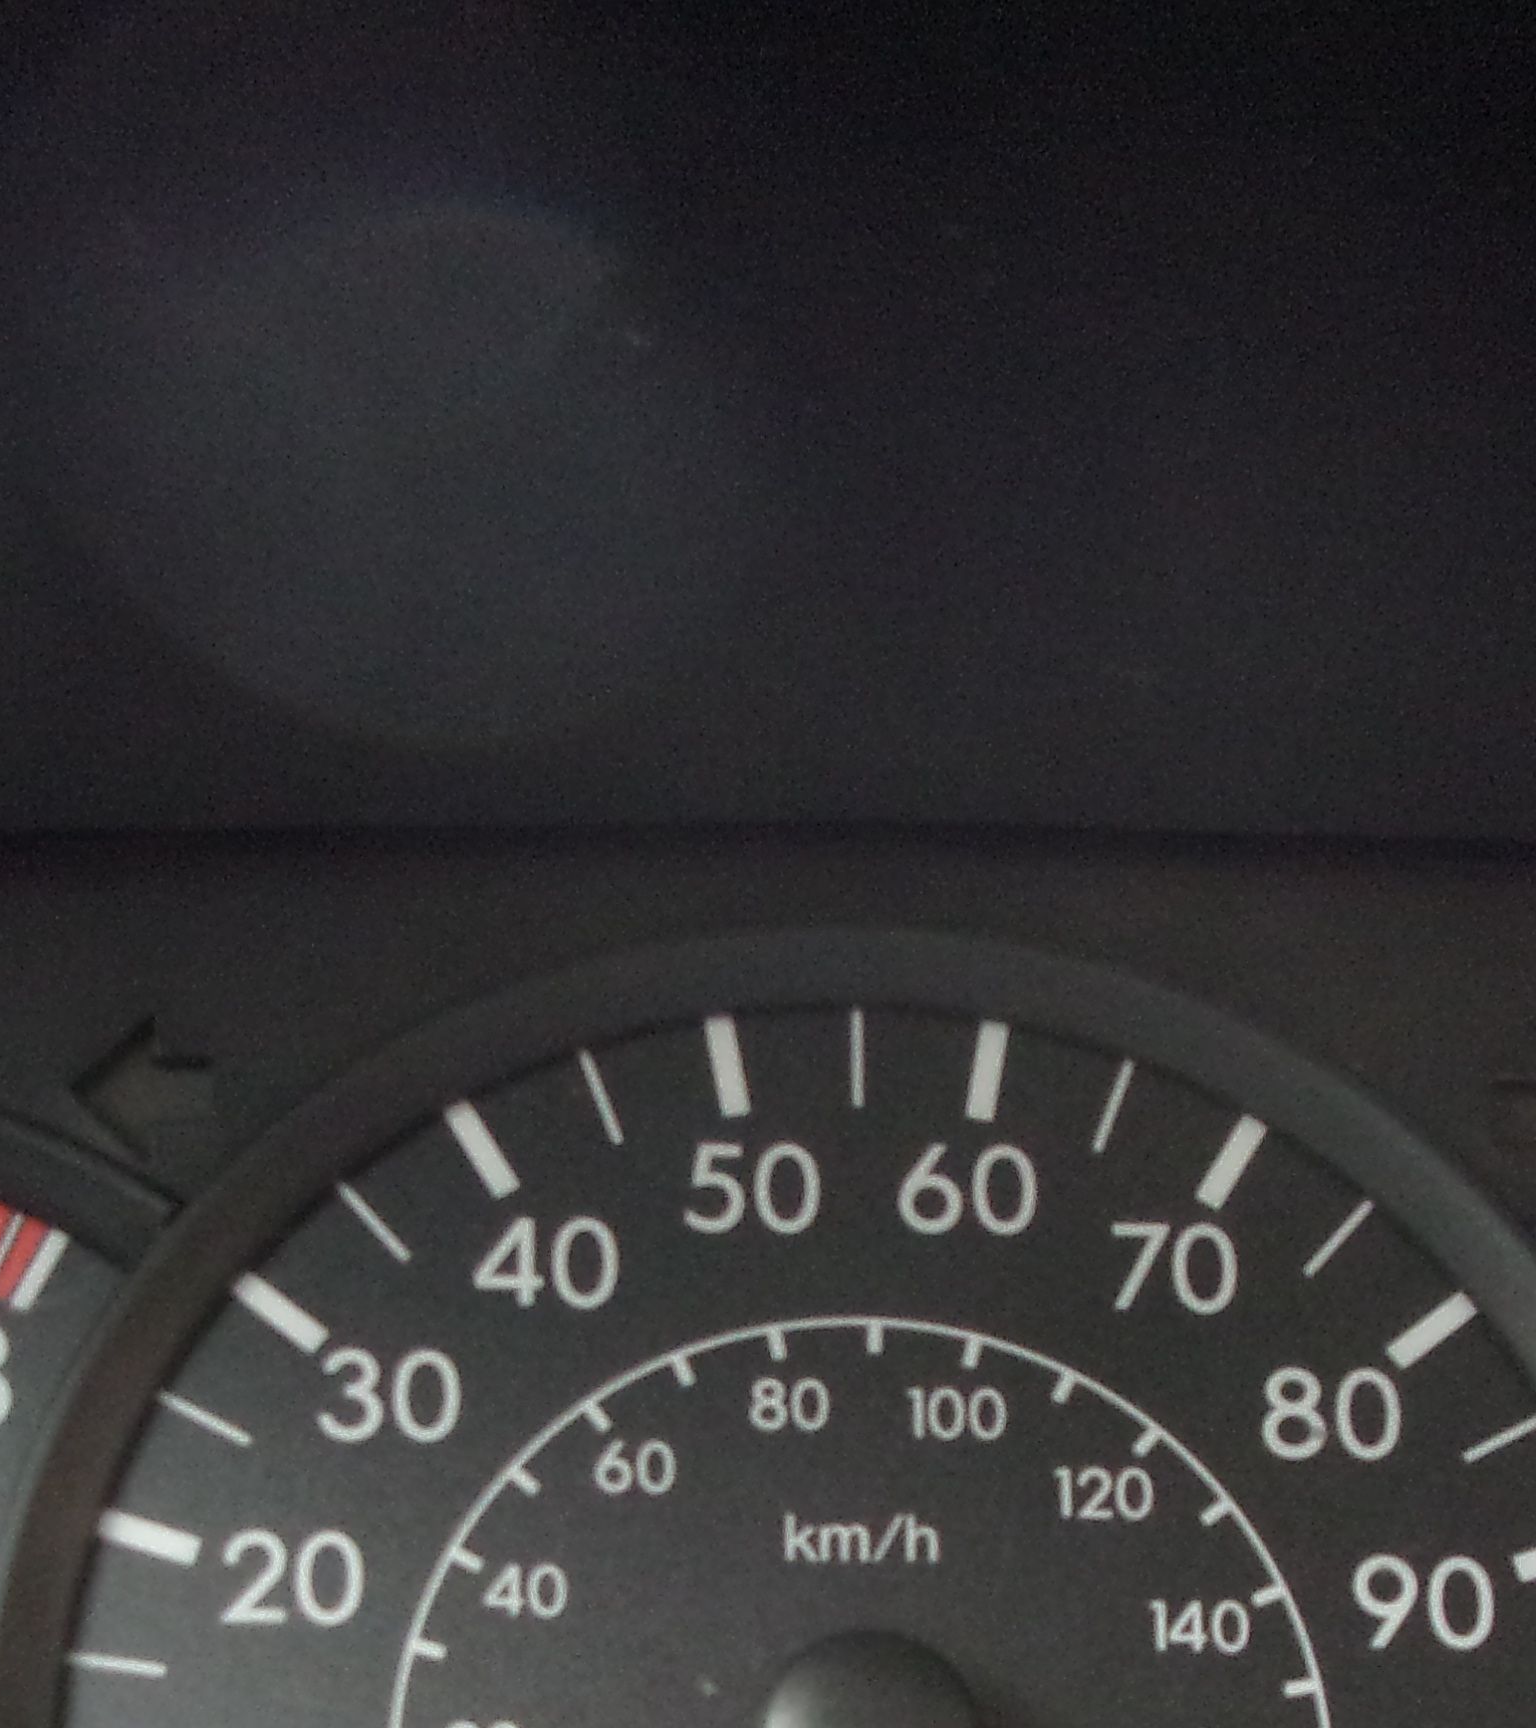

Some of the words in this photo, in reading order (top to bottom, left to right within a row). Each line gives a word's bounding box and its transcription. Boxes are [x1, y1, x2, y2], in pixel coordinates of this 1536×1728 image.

[684, 1142, 820, 1234] 50
[897, 1143, 1037, 1235] 60
[473, 1216, 618, 1310] 40
[1111, 1222, 1237, 1315] 70
[317, 1347, 462, 1443] 30
[749, 1377, 830, 1432] 80
[907, 1386, 1007, 1441] 100
[1261, 1366, 1401, 1461] 80
[593, 1439, 676, 1495] 60
[1055, 1466, 1154, 1521] 120
[220, 1529, 363, 1627] 20
[783, 1513, 940, 1563] km/h
[482, 1563, 568, 1619] 40
[1150, 1599, 1250, 1654] 140
[1352, 1554, 1494, 1651] 90
